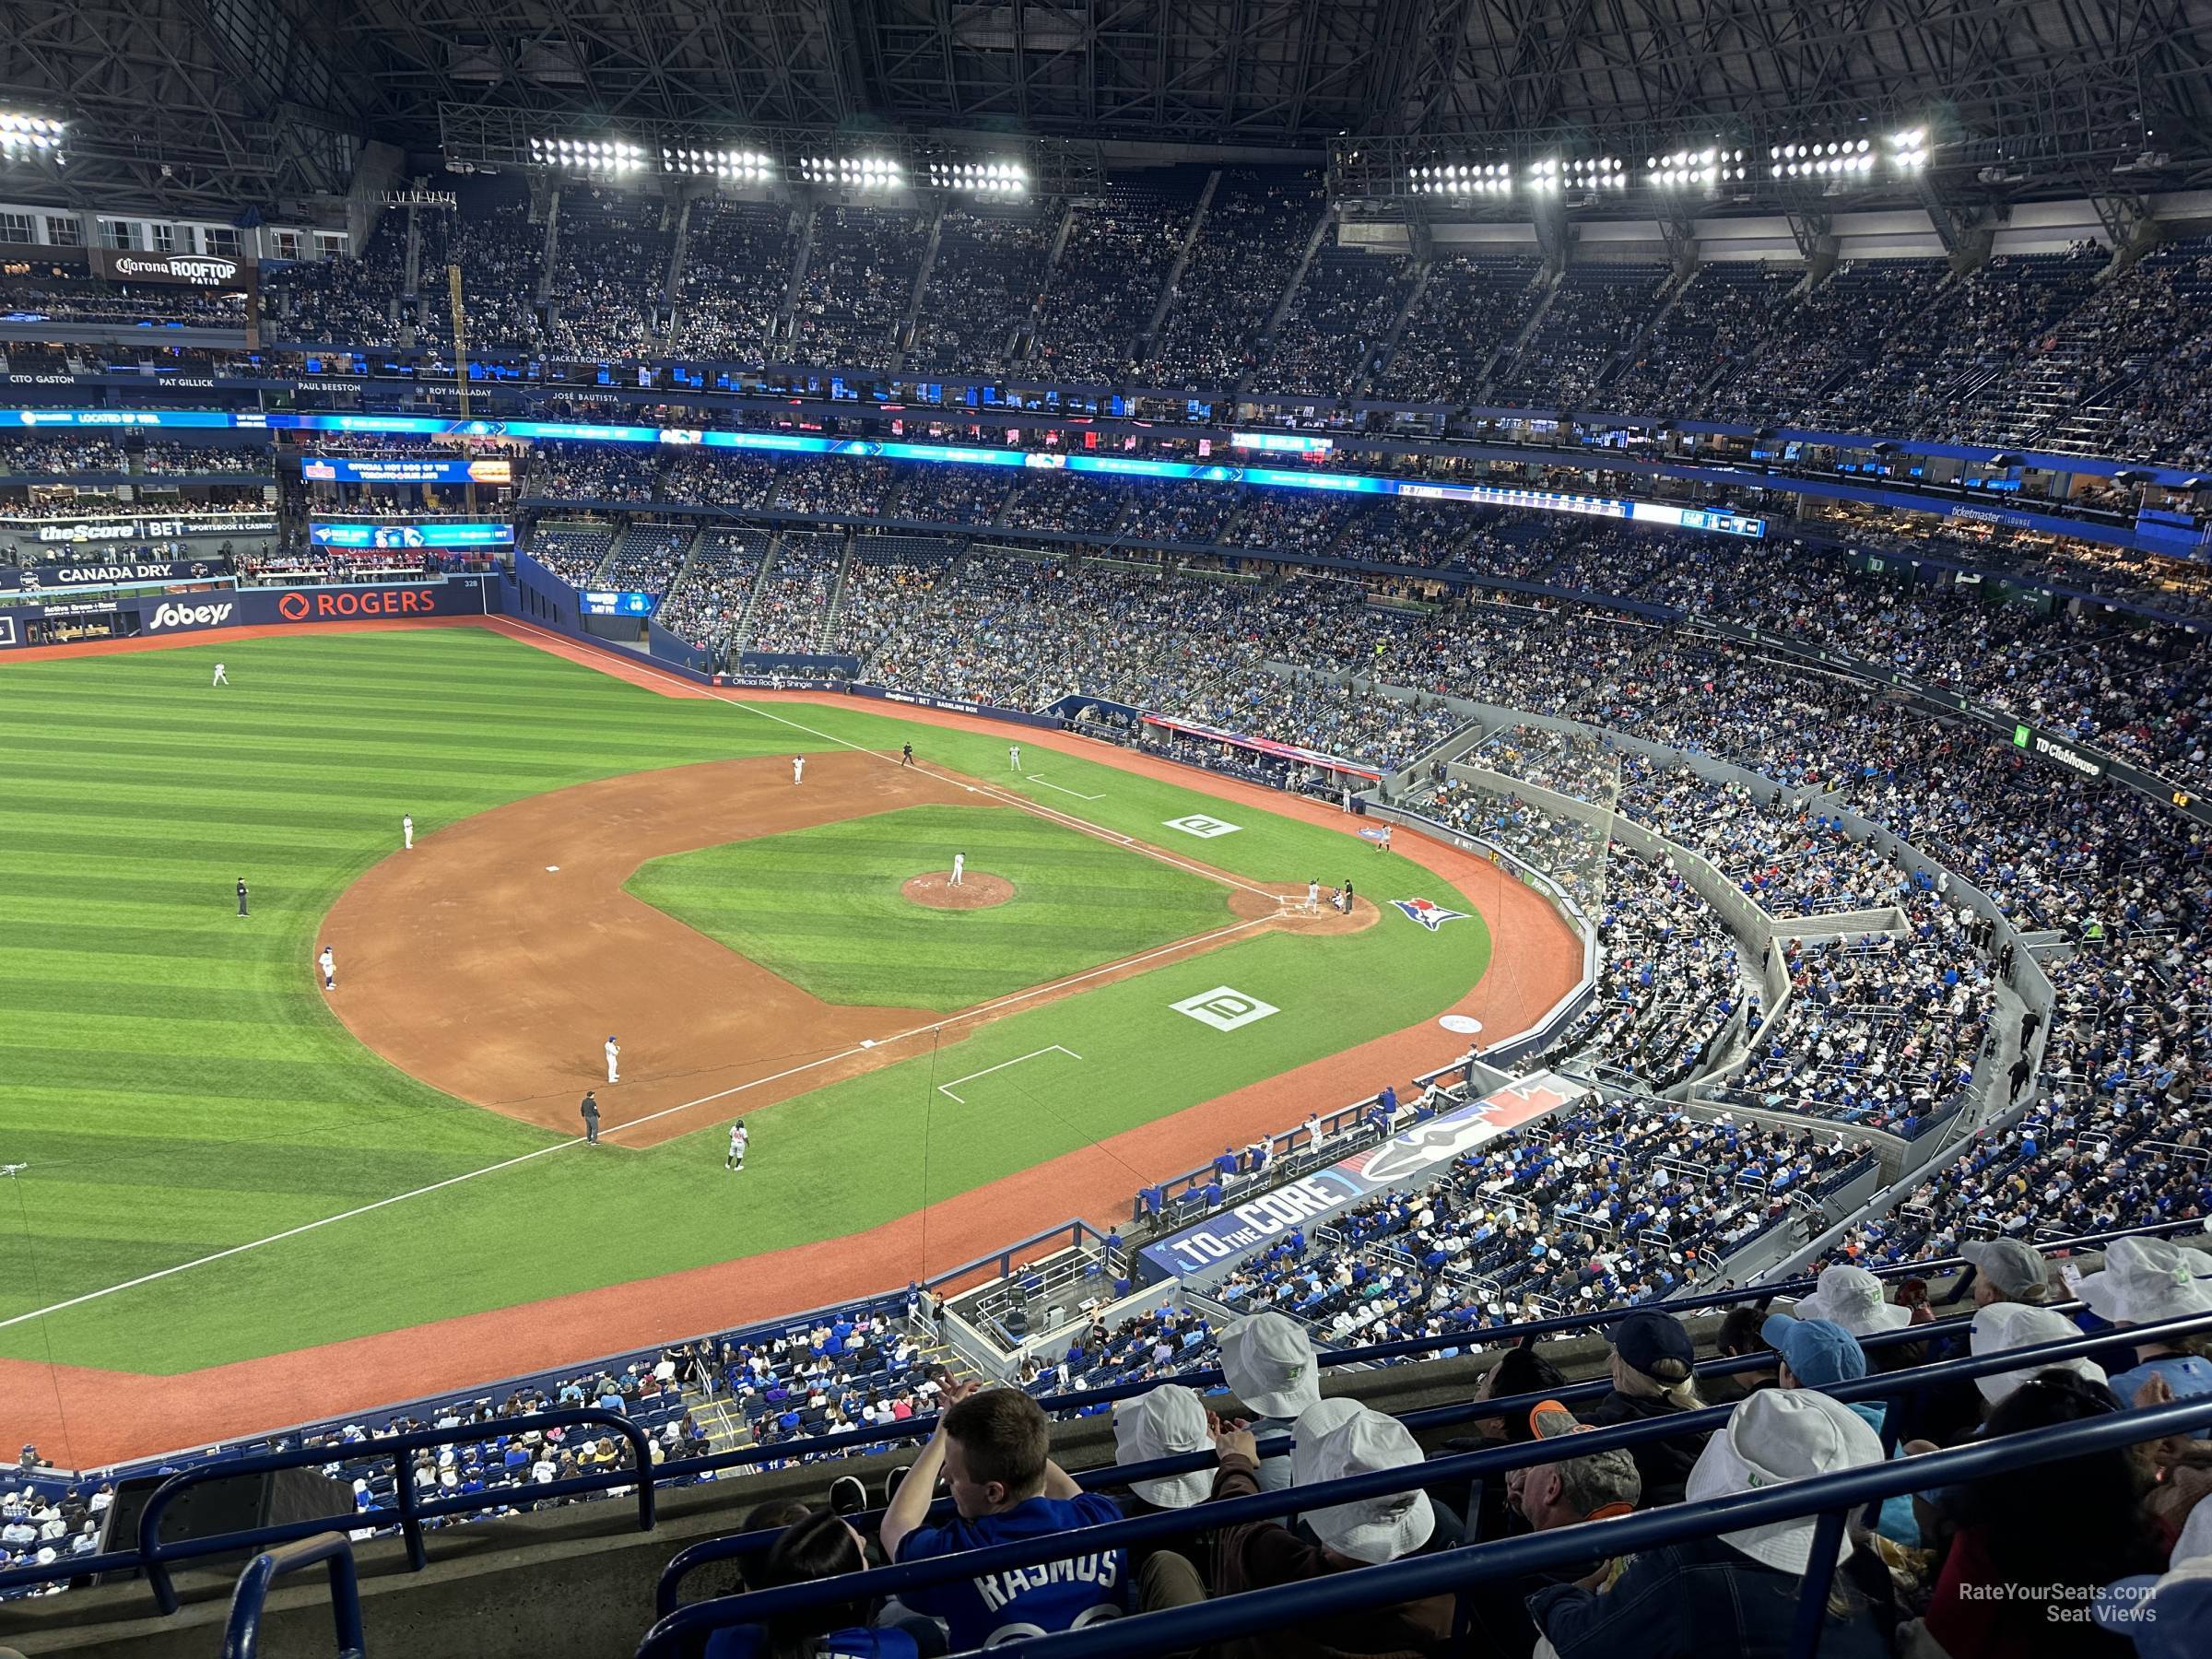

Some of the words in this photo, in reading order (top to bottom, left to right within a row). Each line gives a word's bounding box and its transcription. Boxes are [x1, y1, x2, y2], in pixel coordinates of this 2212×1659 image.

[116, 257, 169, 275] Corona
[171, 261, 236, 278] ROOFTOP
[550, 355, 579, 363] JACKIE
[581, 357, 623, 365] ROBINSON
[10, 375, 32, 383] CITO
[36, 376, 75, 384] GASTON
[159, 378, 176, 386] PAT
[178, 379, 214, 387] GILLICK
[298, 382, 320, 391] PAUL
[322, 383, 361, 393] BEESTON
[429, 387, 446, 395] ROY
[448, 388, 492, 397] HALLADAY
[553, 392, 574, 400] JOSÉ
[578, 394, 618, 402] BAUTISTA
[347, 463, 382, 472] OFFICIAL
[1951, 505, 2000, 523] ticketmaster
[2007, 516, 2031, 526] LOUNGE
[41, 525, 134, 539] theScore
[150, 522, 184, 536] BET
[58, 568, 134, 582] CANADA
[44, 606, 69, 614] Active
[317, 590, 436, 616] ROGERS
[150, 602, 233, 630] Sobeys
[733, 677, 757, 686] Official
[786, 680, 813, 688] Shingle
[936, 700, 965, 711] BASELINE
[965, 705, 978, 713] BOX
[2036, 737, 2050, 753] TD
[2048, 744, 2100, 776] Clubhouse
[1179, 818, 1223, 834] TD
[1186, 994, 1257, 1021] TD
[1233, 1176, 1348, 1235] CORE
[1221, 1227, 1263, 1249] THE
[1170, 1231, 1231, 1265] TO
